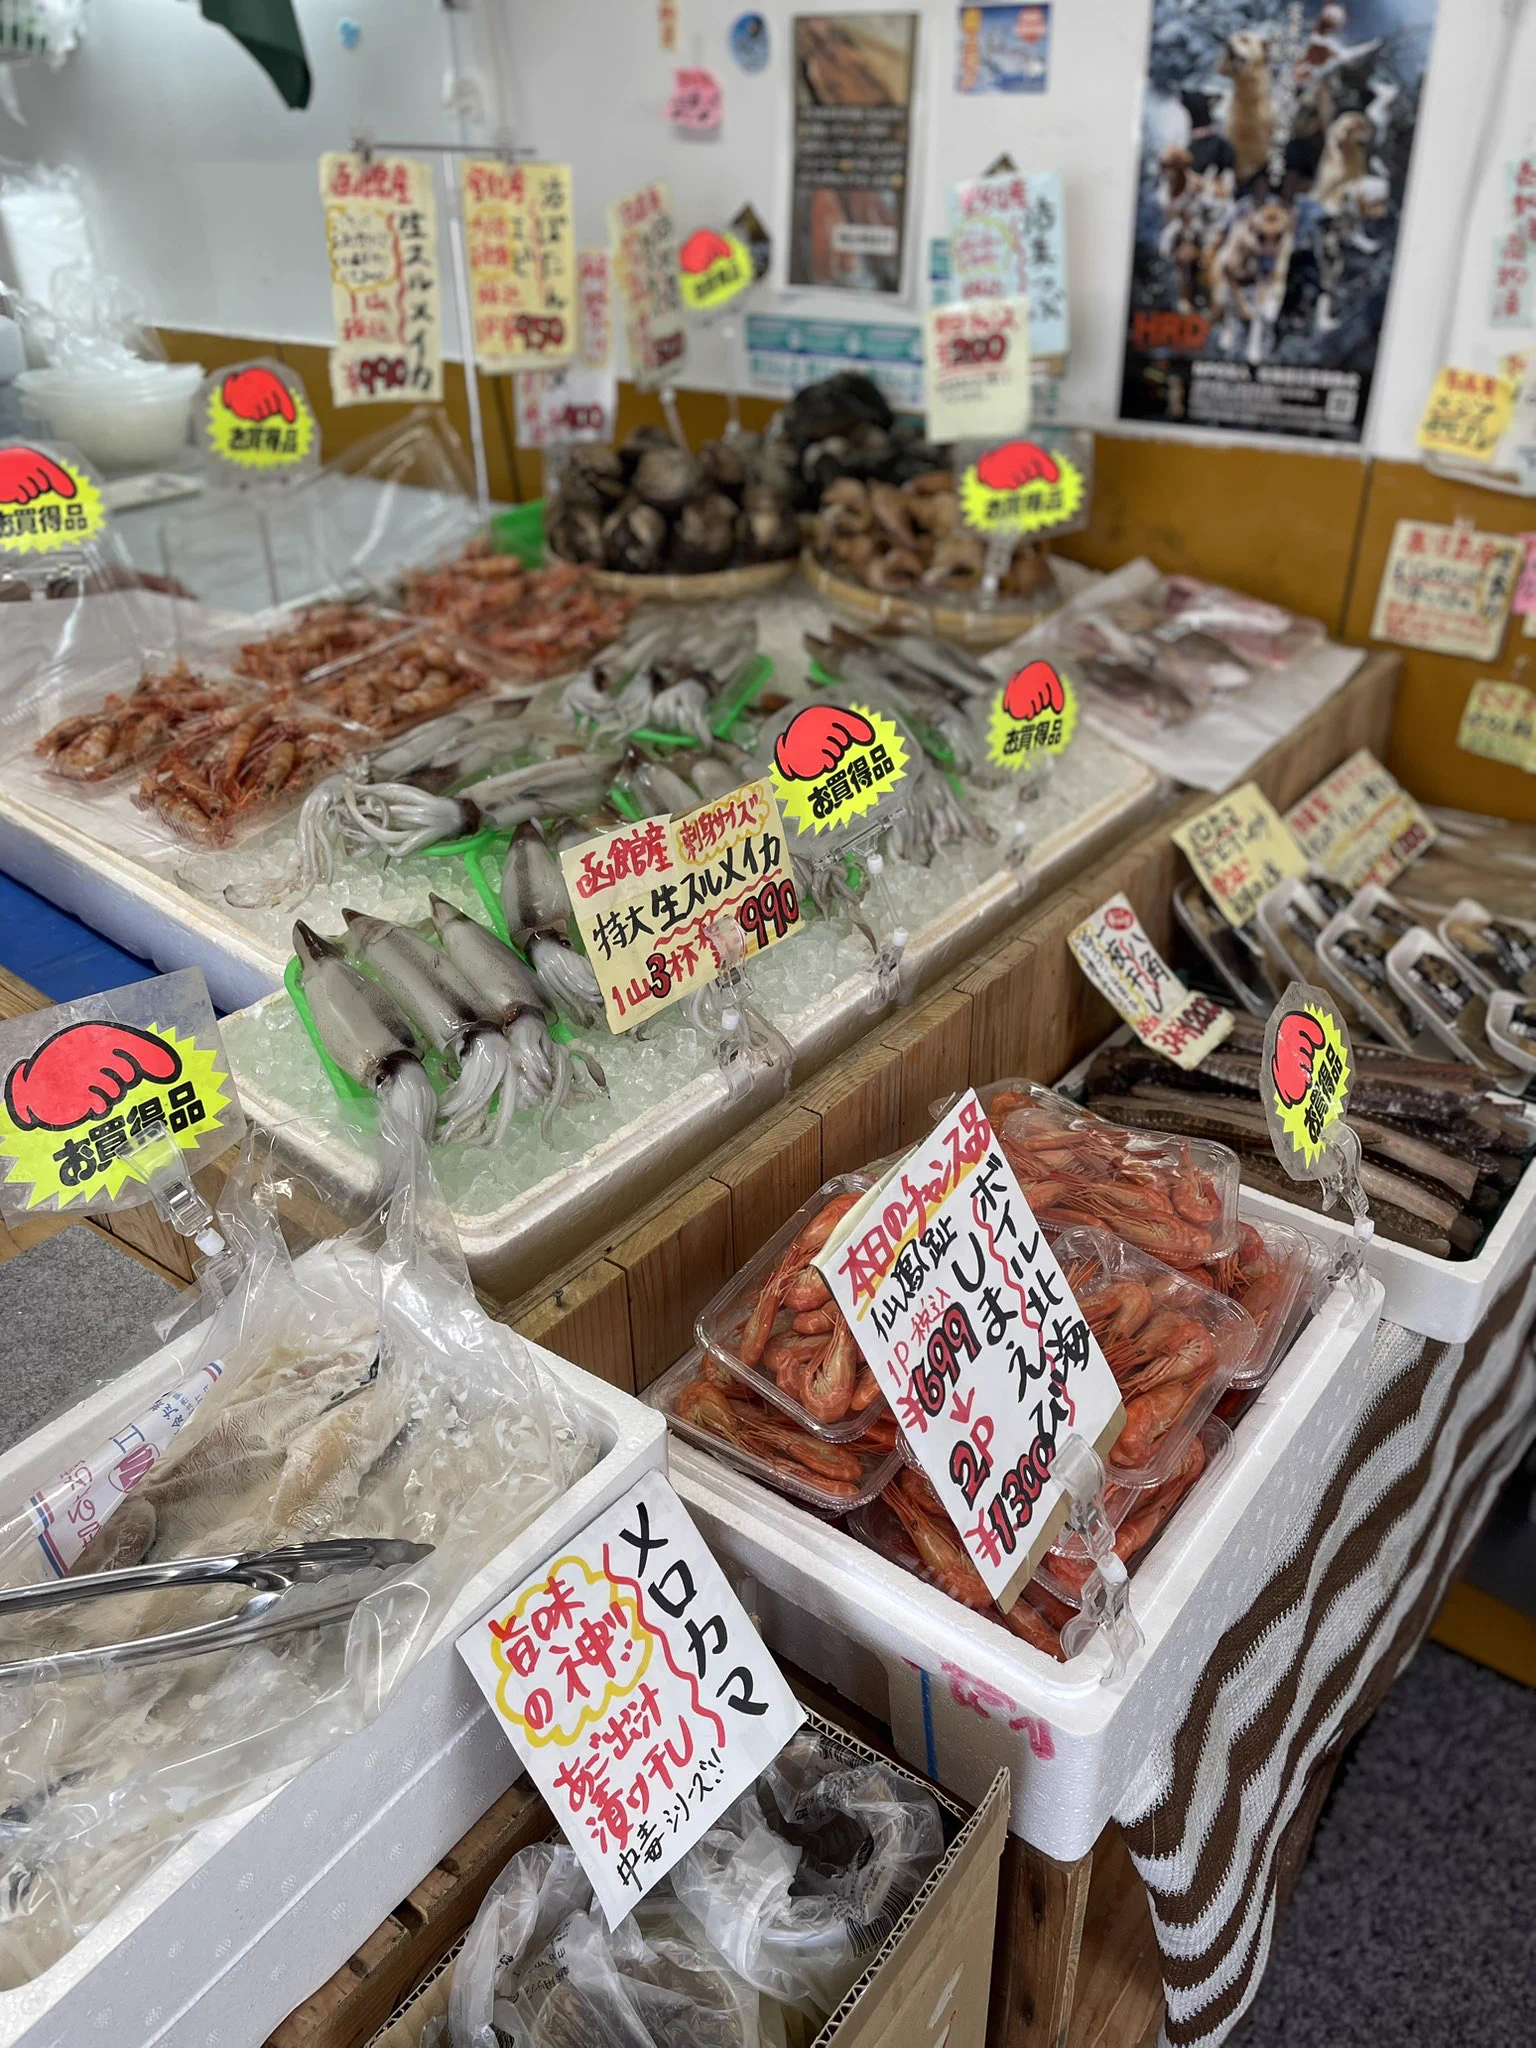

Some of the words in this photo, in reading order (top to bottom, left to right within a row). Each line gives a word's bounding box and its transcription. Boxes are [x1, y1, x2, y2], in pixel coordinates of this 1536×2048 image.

[808, 743, 896, 819] お買得品
[1003, 719, 1063, 755] お買得品
[575, 821, 674, 899] 函館産
[53, 1080, 206, 1187] お買得品
[1303, 1042, 1344, 1145] お買得品
[838, 1097, 992, 1306] 本日のチャンス品
[949, 1415, 995, 1511] 2P
[487, 1575, 587, 1678] 旨味
[618, 1502, 770, 1717] メロカマ
[553, 1682, 662, 1812] あご出汁
